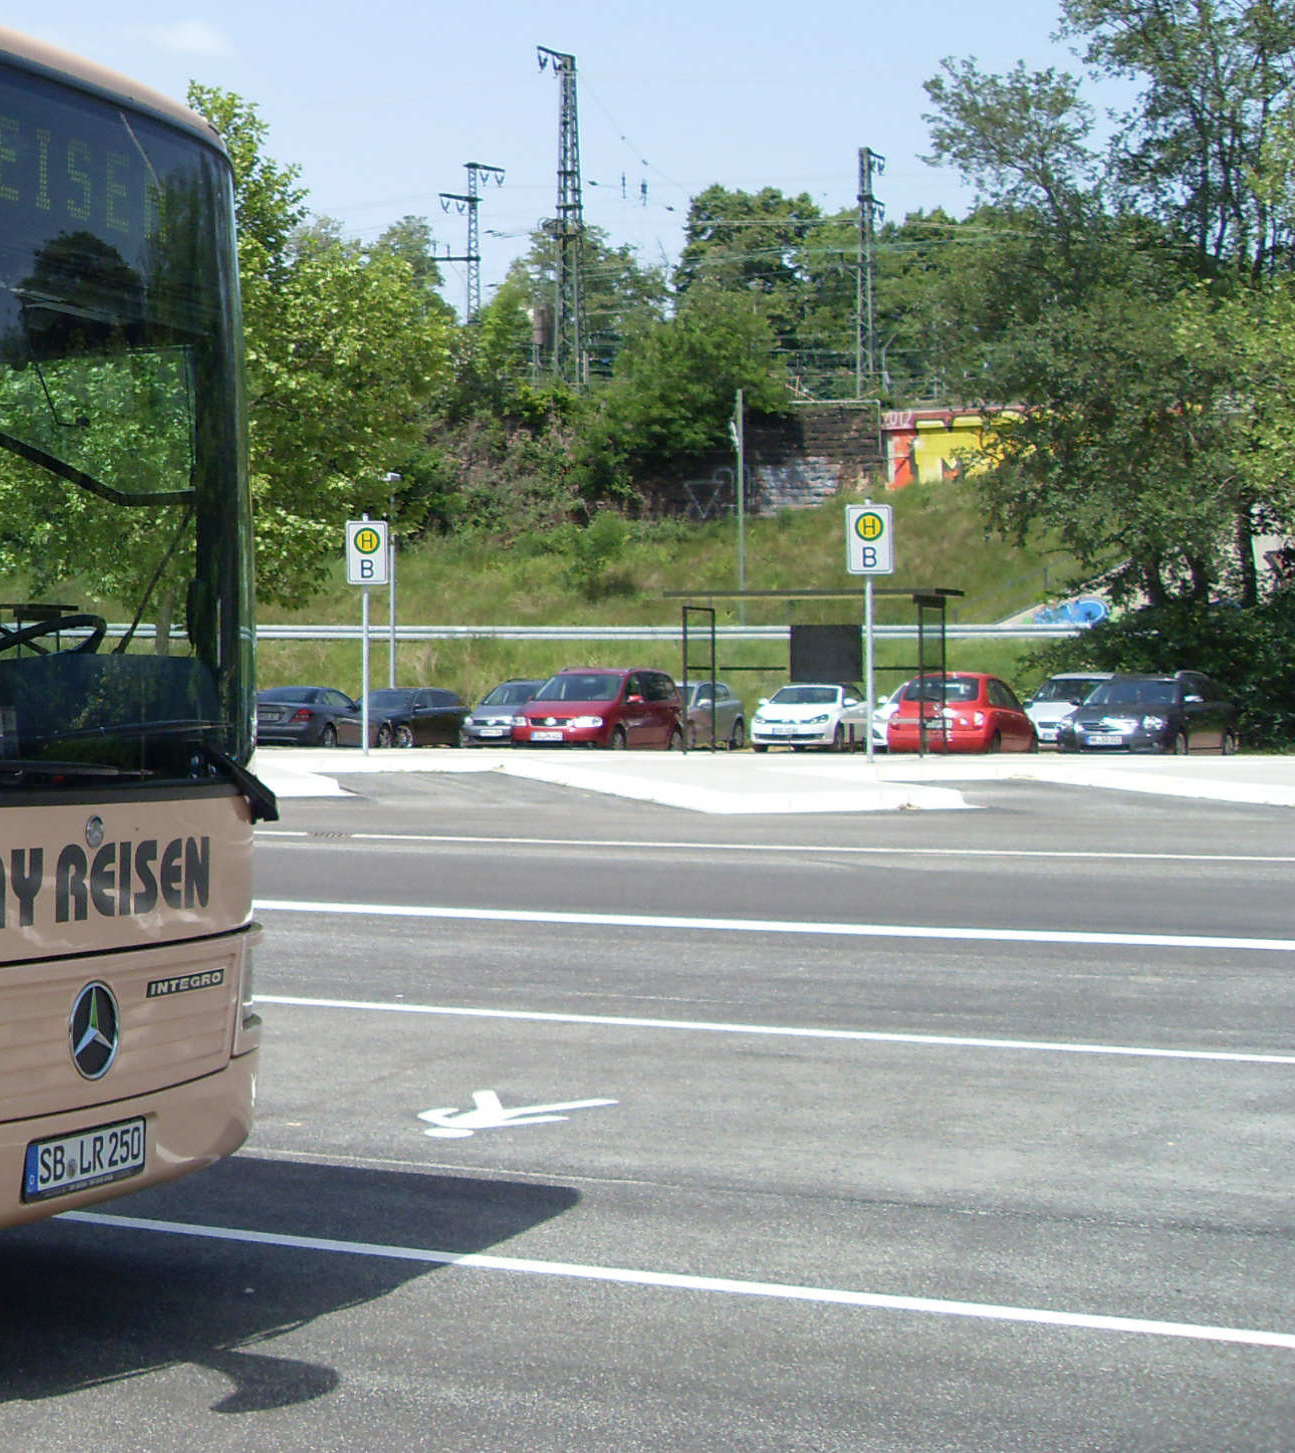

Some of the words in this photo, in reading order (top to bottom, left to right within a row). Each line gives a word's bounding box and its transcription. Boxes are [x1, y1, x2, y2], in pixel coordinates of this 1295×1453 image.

[863, 518, 876, 535] H
[361, 533, 373, 549] H
[862, 546, 877, 568] B
[360, 559, 374, 579] B
[55, 836, 210, 923] REISEN
[150, 971, 222, 996] INTEGRO
[39, 1144, 66, 1185] SB
[79, 1135, 104, 1175] LR
[108, 1126, 141, 1168] 250
